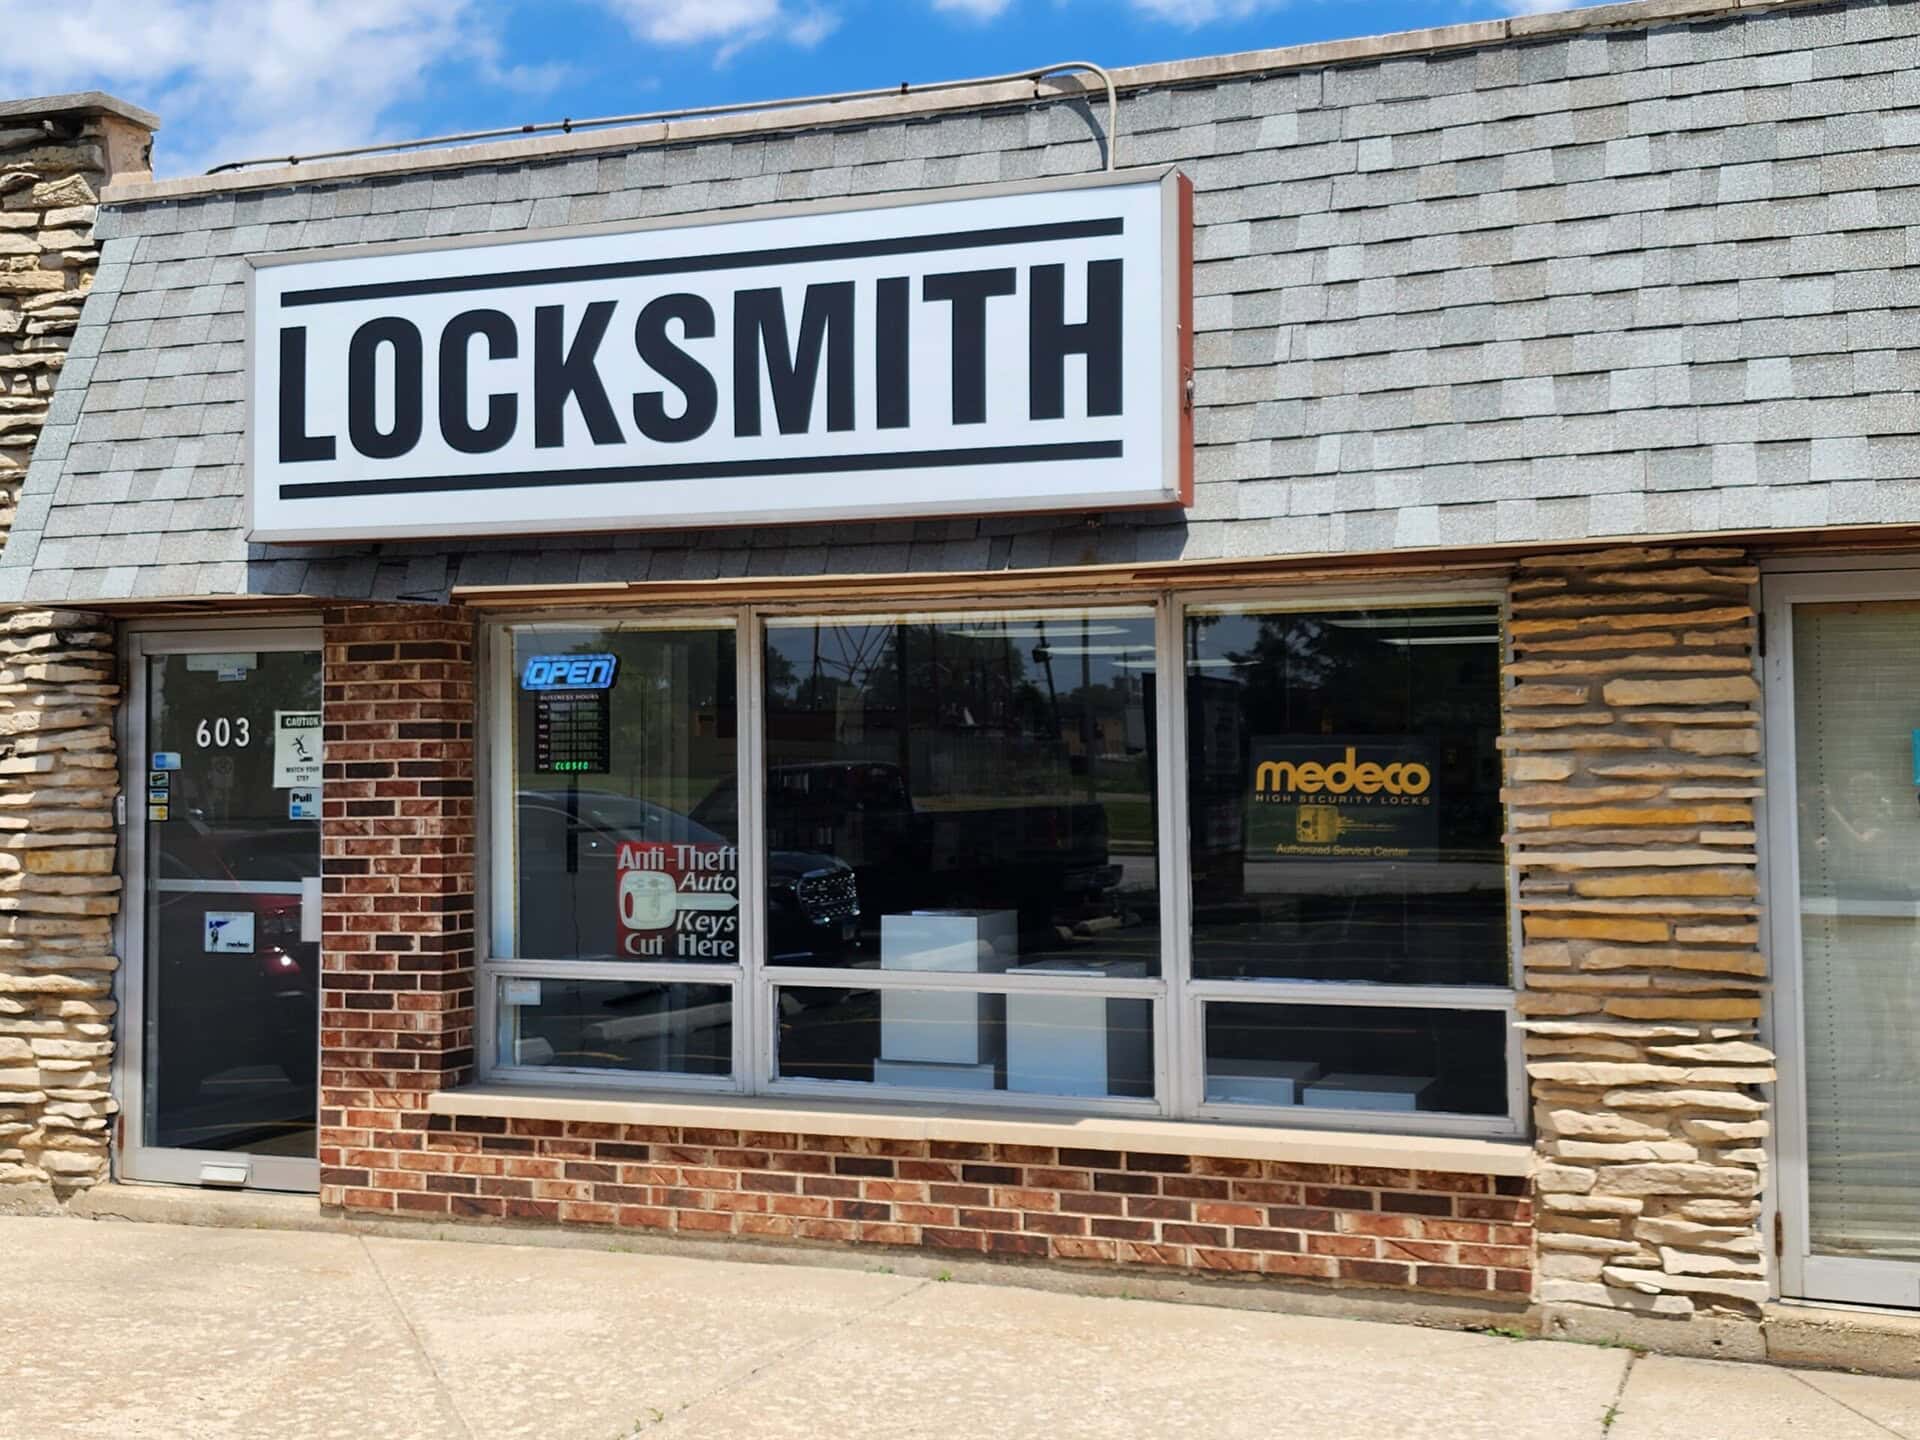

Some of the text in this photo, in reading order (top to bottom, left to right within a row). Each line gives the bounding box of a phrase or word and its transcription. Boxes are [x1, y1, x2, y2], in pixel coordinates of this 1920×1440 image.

[279, 258, 1123, 463] LOCKSMITH
[527, 659, 611, 685] OPEN
[195, 716, 251, 748] 603
[286, 716, 320, 727] CAUTION
[555, 761, 589, 771] CLOSED
[1256, 746, 1431, 795] medeco
[292, 793, 313, 802] Pull
[1255, 794, 1431, 806] HIGH SECURITY LOCKS
[1275, 843, 1411, 857] Authorized Service Center
[678, 871, 737, 892] Auto
[676, 910, 737, 939] Keys
[624, 932, 736, 957] Cut Here
